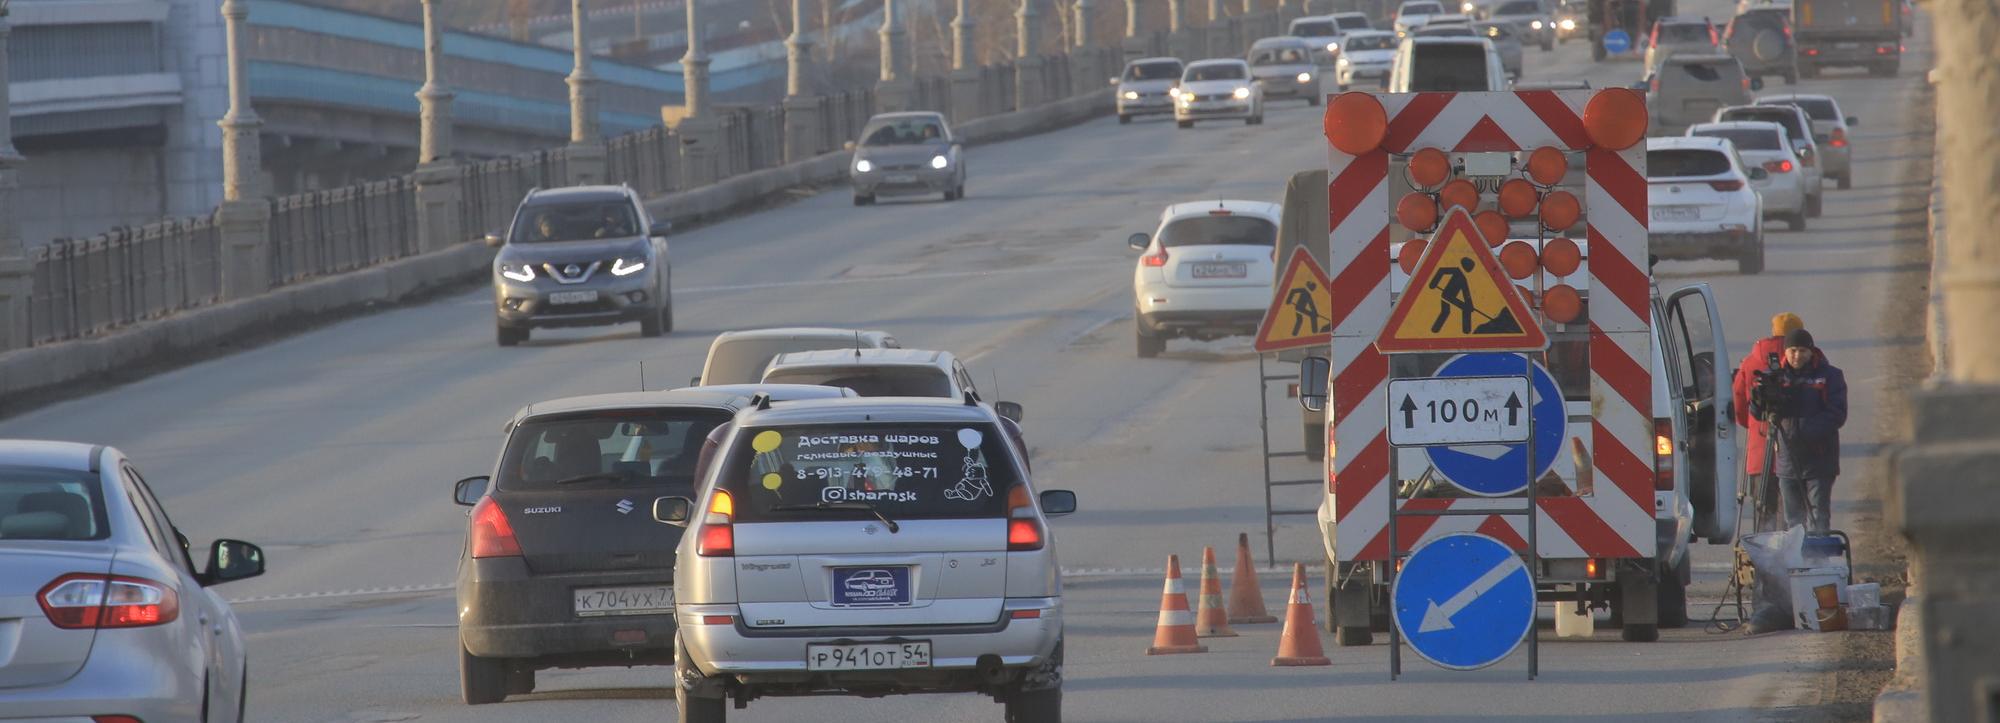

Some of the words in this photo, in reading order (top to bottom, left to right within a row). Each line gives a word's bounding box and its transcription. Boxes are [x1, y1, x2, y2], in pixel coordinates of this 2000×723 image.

[798, 434, 879, 448] Доставка
[884, 433, 940, 445] шаров
[796, 467, 938, 480] 8-913-479-48-71
[849, 490, 917, 502] sharnsk
[523, 506, 562, 514] SUZUKI
[903, 644, 923, 660] 54
